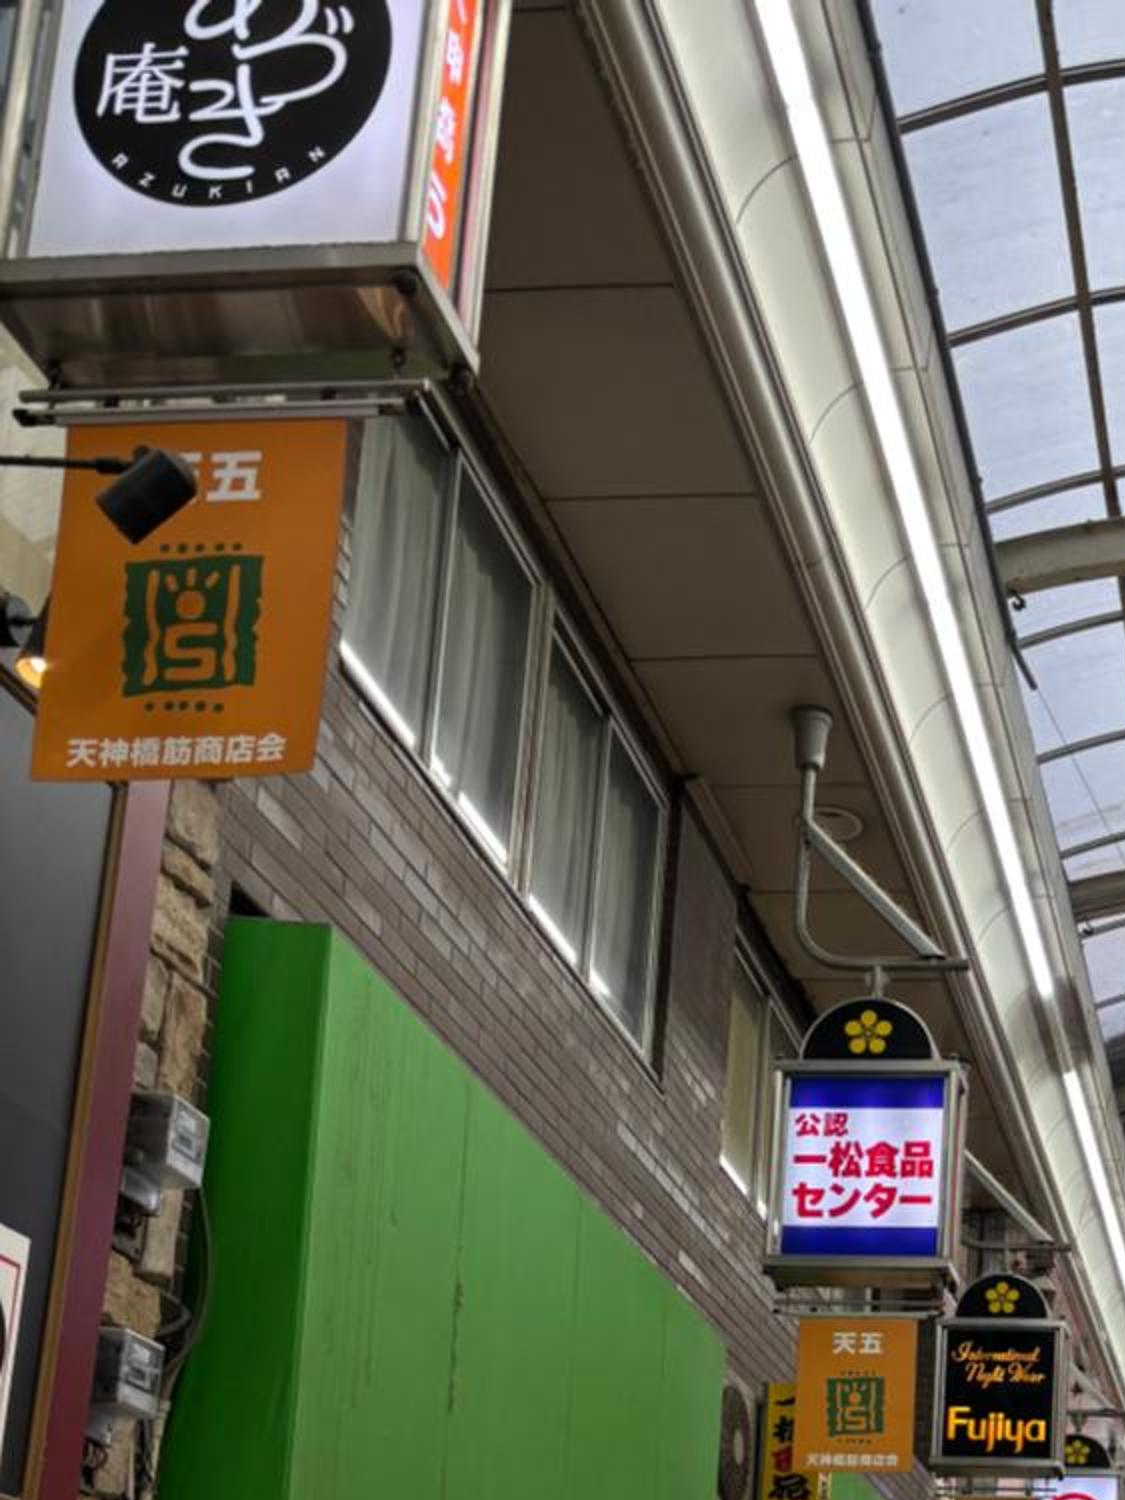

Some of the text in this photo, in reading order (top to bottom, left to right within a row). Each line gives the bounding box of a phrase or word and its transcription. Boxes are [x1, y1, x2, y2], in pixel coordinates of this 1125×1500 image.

[97, 42, 189, 124] 庵
[111, 146, 327, 201] AZUKIAN
[66, 733, 287, 769] 天神橋筋商店会
[794, 1112, 849, 1137] 公認
[793, 1140, 934, 1179] 一松食品
[792, 1182, 933, 1219] センター
[832, 1330, 883, 1354] 天五
[947, 1405, 1047, 1454] Fujiya
